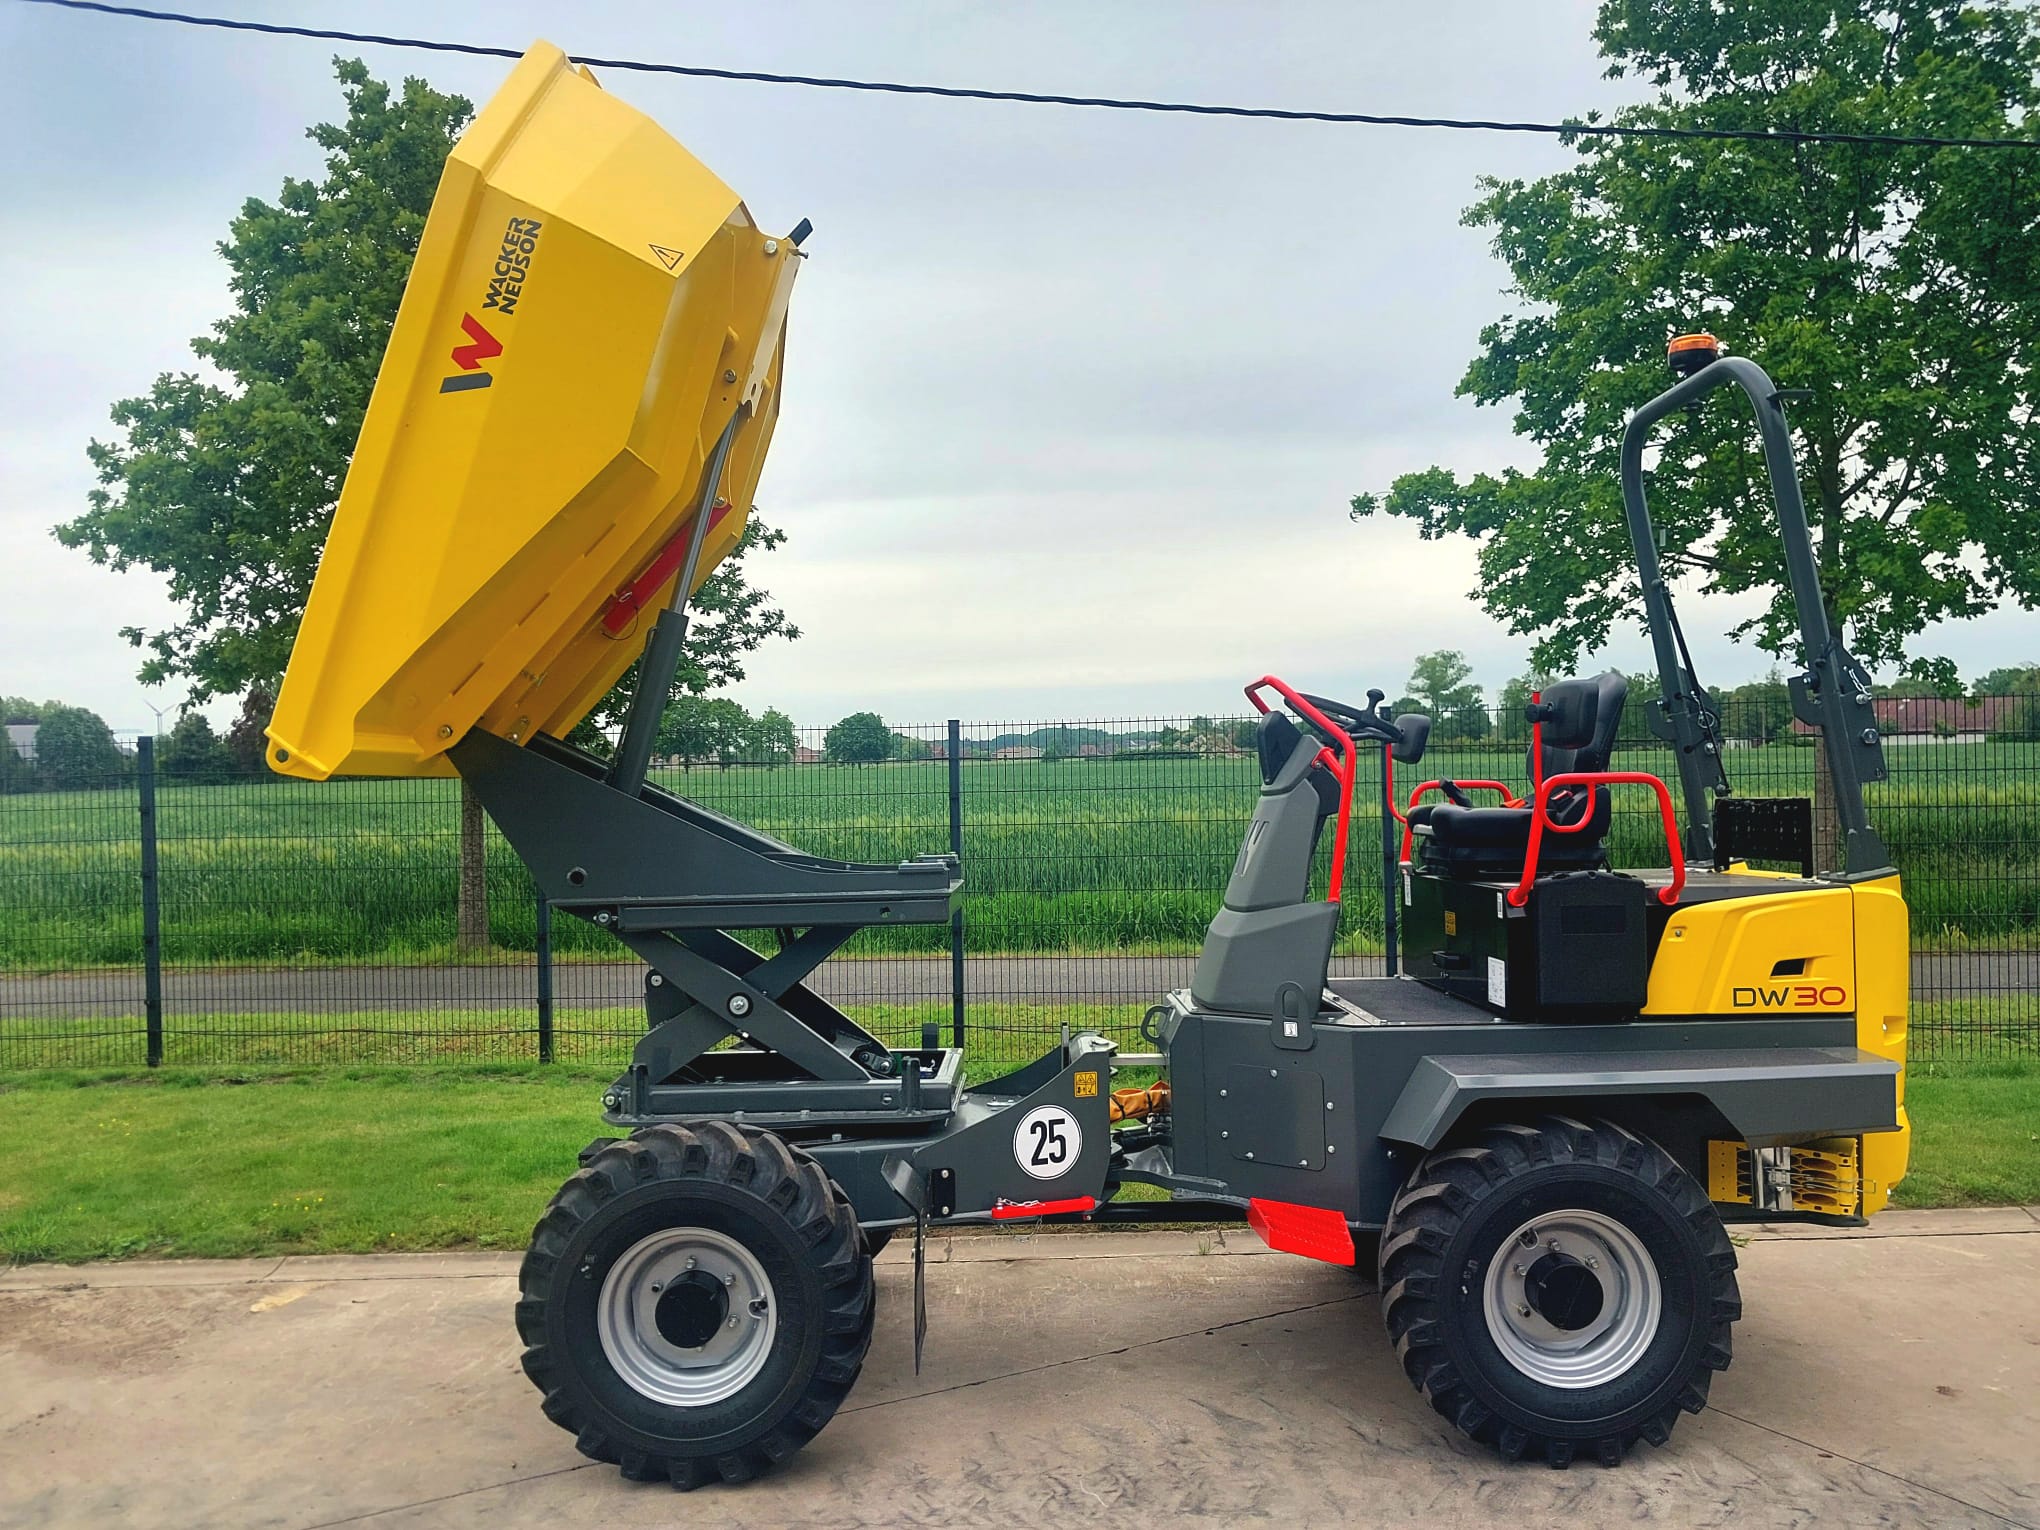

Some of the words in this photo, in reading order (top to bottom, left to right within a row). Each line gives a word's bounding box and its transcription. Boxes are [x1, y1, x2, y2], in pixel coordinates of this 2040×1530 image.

[482, 217, 526, 309] WACKER
[498, 219, 542, 315] NEUSON
[1732, 986, 1847, 1007] DW30
[1029, 1118, 1067, 1166] 25
